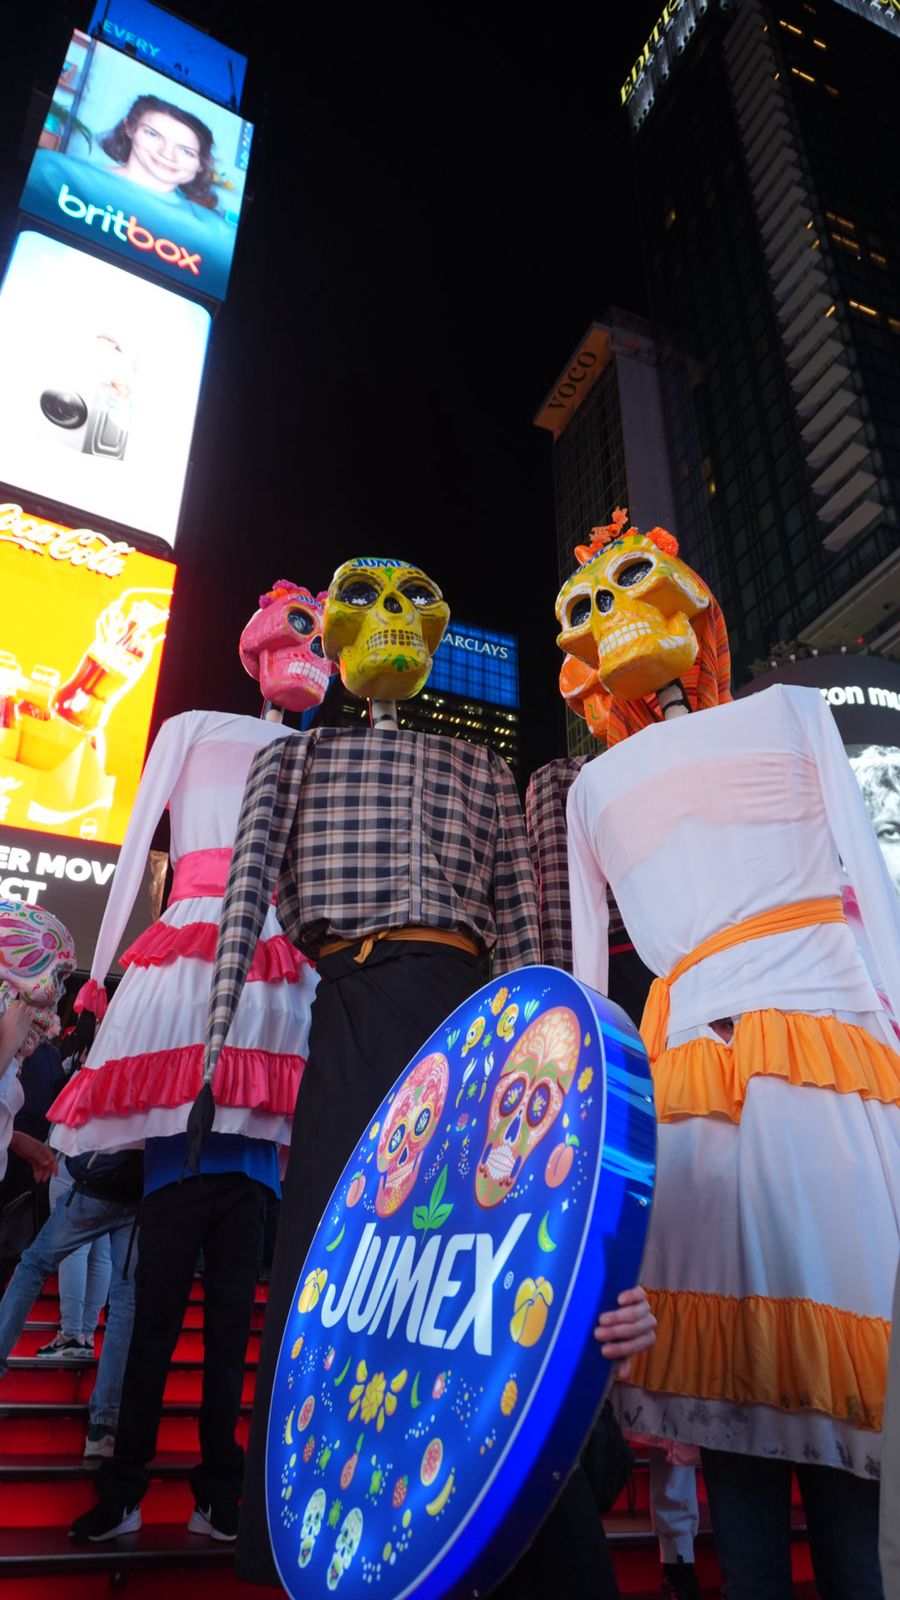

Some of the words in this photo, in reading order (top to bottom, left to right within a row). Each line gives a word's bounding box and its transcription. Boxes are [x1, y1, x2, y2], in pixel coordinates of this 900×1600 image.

[102, 19, 160, 57] EVERY
[57, 183, 203, 275] britbox
[547, 351, 597, 408] VOCO
[321, 1212, 532, 1357] JUMEX
